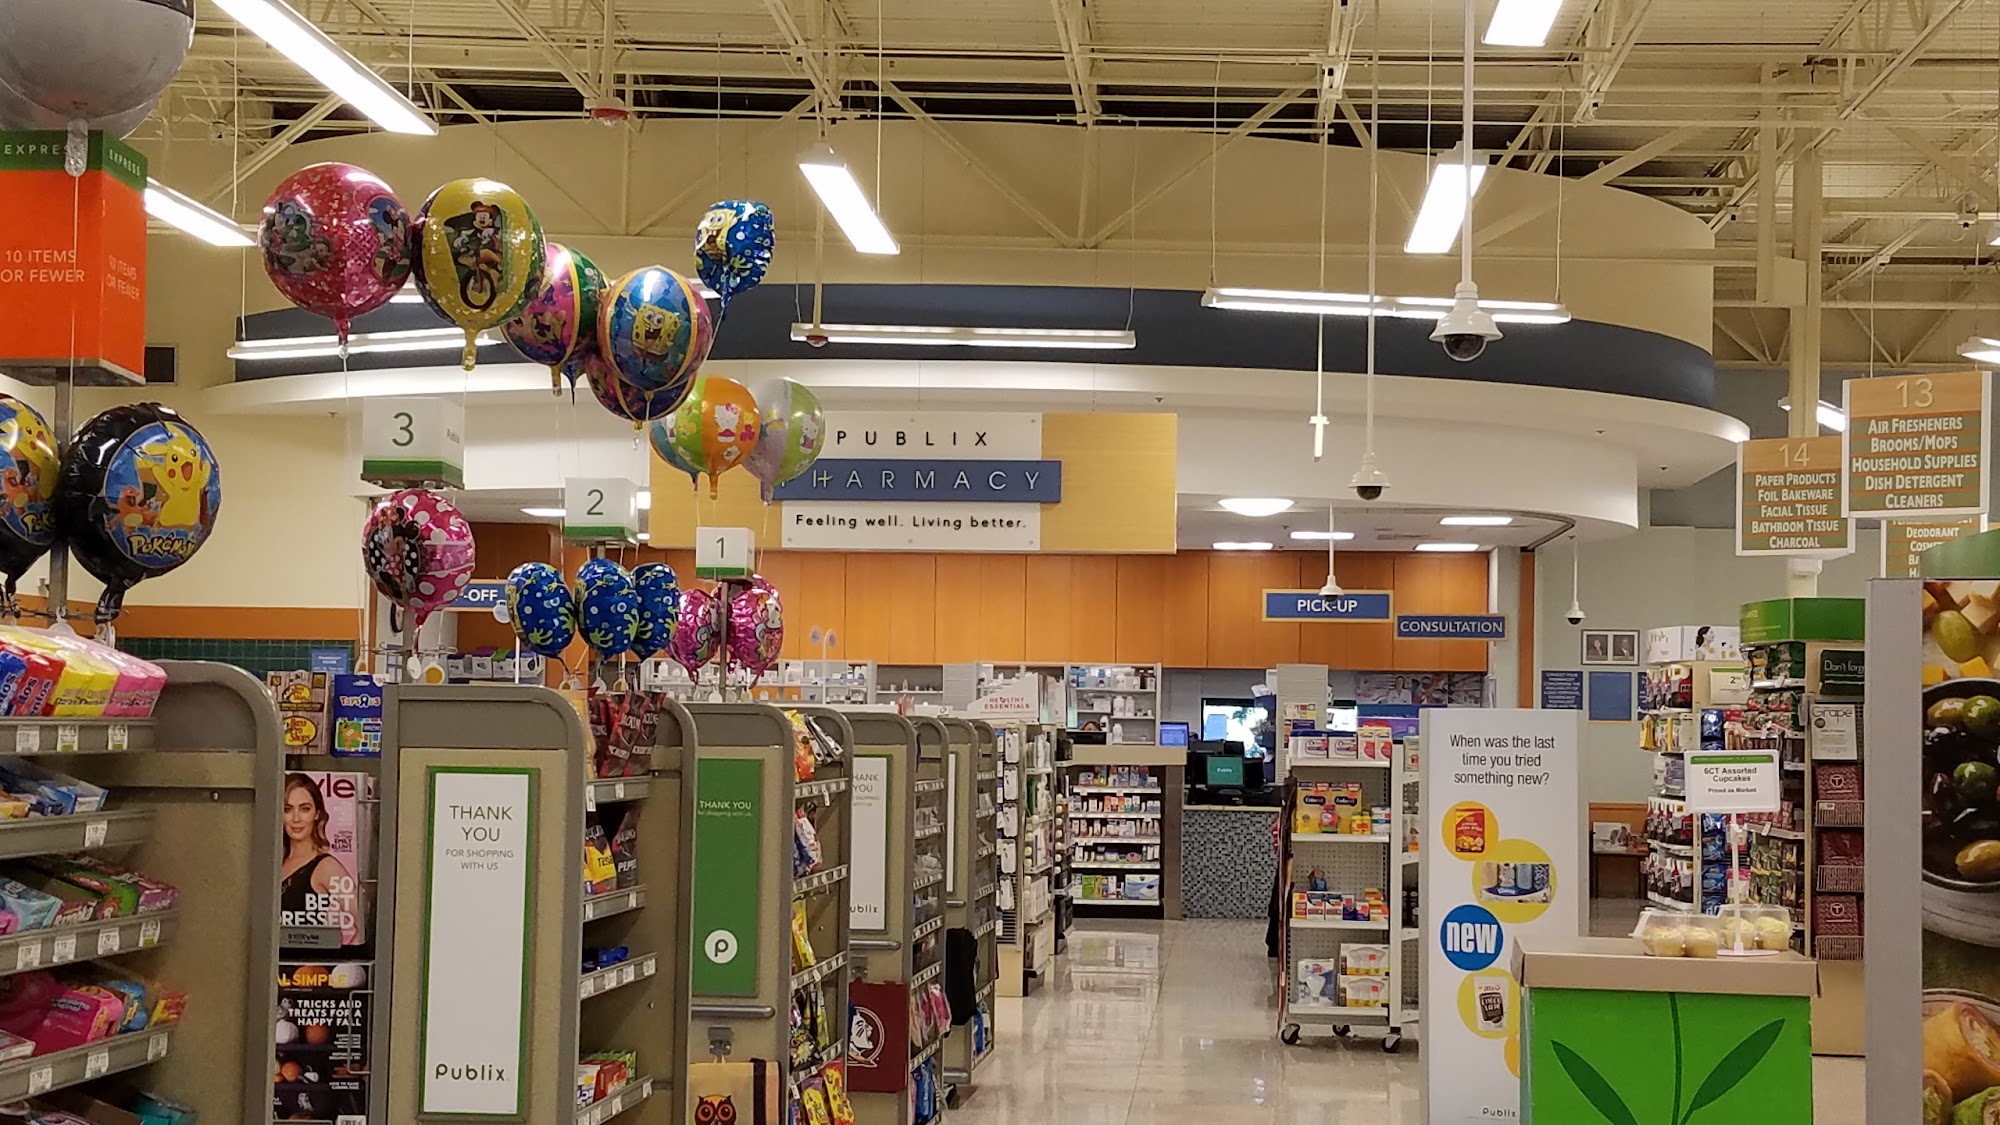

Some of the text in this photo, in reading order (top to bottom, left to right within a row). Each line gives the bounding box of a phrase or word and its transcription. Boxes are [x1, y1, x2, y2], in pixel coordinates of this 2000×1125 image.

[4, 144, 71, 155] EXPRE
[108, 149, 142, 177] EXPRESS
[6, 250, 76, 263] 10 ITEMS
[0, 269, 85, 282] OR FEWER
[117, 258, 138, 281] ITEMS
[105, 273, 140, 300] OR FEWER
[1896, 377, 1934, 408] 13
[392, 412, 414, 446] 3
[1867, 416, 1963, 435] AIR FRESHENERS
[837, 430, 987, 446] PUBLIX
[1871, 435, 1958, 453] BROOMS/MOPS
[1779, 442, 1811, 467] 14
[1852, 455, 1977, 472] HOUSEHOLD SUPPLIES
[782, 470, 1040, 490] HARMACY
[1755, 472, 1836, 487] PAPER PRODUCTS
[1865, 473, 1964, 491] DISH DETERGENT
[586, 489, 604, 516] 2
[1758, 488, 1834, 502] FOIL BAKEWARE
[1885, 493, 1944, 509] CLEANERS
[1761, 503, 1828, 518] FACIAL TISSUE
[796, 514, 1026, 530] Feeling well. Living better.
[1751, 519, 1839, 534] BATHROOM TISSUE
[1906, 527, 1959, 539] DEODORANT
[715, 537, 725, 558] 1
[1769, 536, 1821, 549] CHARCOAL
[1297, 599, 1358, 613] PICK-UP
[1400, 620, 1503, 633] CONSULTATION
[1824, 660, 1864, 674] Don't forg
[1811, 706, 1854, 723] Grape
[1449, 734, 1555, 749] When was the last
[1462, 752, 1541, 769] time you tried
[1454, 771, 1550, 787] something new?
[1712, 775, 1751, 783] Cupcakes
[853, 784, 873, 793] YOU
[449, 805, 513, 821] THANK
[699, 800, 752, 810] THANK YOU
[461, 826, 501, 842] YOU
[445, 848, 514, 859] FOR SHOPPING
[460, 861, 499, 871] WITH US
[329, 876, 354, 894] 50
[305, 893, 354, 911] BEST
[849, 903, 879, 914] ublix
[281, 911, 355, 929] RESSED
[1446, 921, 1498, 954] new
[291, 974, 347, 987] SIMPLE
[297, 1000, 336, 1008] TRICKS
[288, 1008, 362, 1017] TREATS FOR A
[297, 1017, 332, 1026] HAPPY
[435, 1063, 505, 1082] Publix
[1483, 1107, 1516, 1118] Publix
